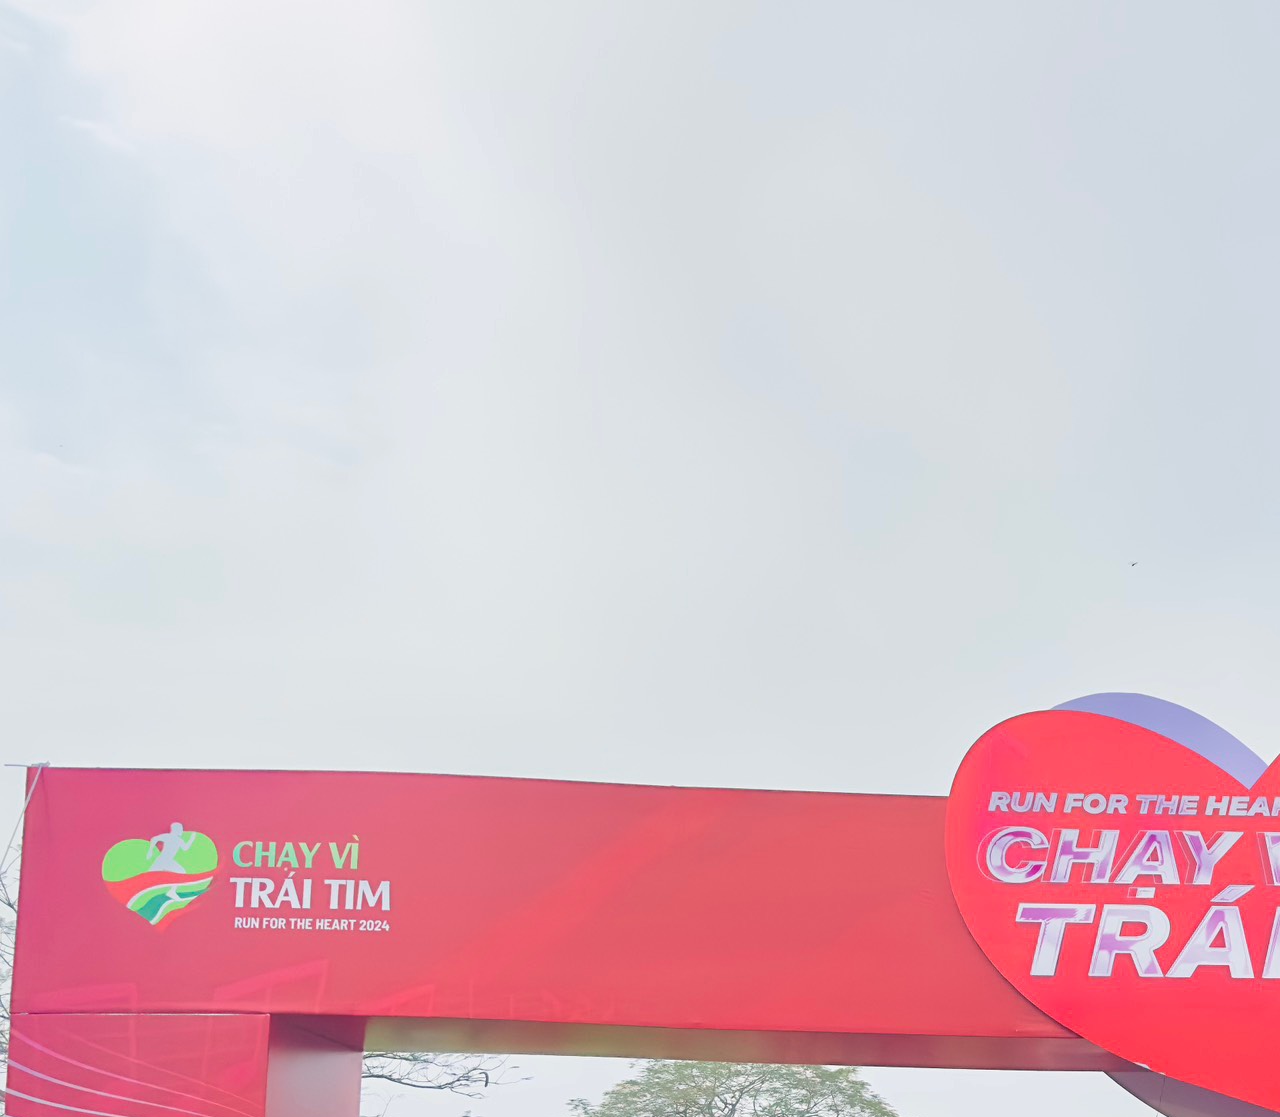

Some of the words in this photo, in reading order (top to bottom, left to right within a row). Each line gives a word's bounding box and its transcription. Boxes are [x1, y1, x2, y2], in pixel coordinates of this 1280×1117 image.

[988, 792, 1057, 813] RUN
[1064, 793, 1128, 815] FOR
[1136, 794, 1199, 815] THE
[232, 841, 323, 871] CHẠY
[326, 835, 360, 870] VÌ
[978, 825, 1243, 896] CHẠY
[230, 871, 312, 909] TRÁI
[325, 878, 391, 911] TIM
[234, 917, 259, 929] RUN
[262, 918, 286, 930] FOR
[289, 918, 312, 930] THE
[316, 919, 355, 931] HEART
[359, 919, 390, 931] 2024
